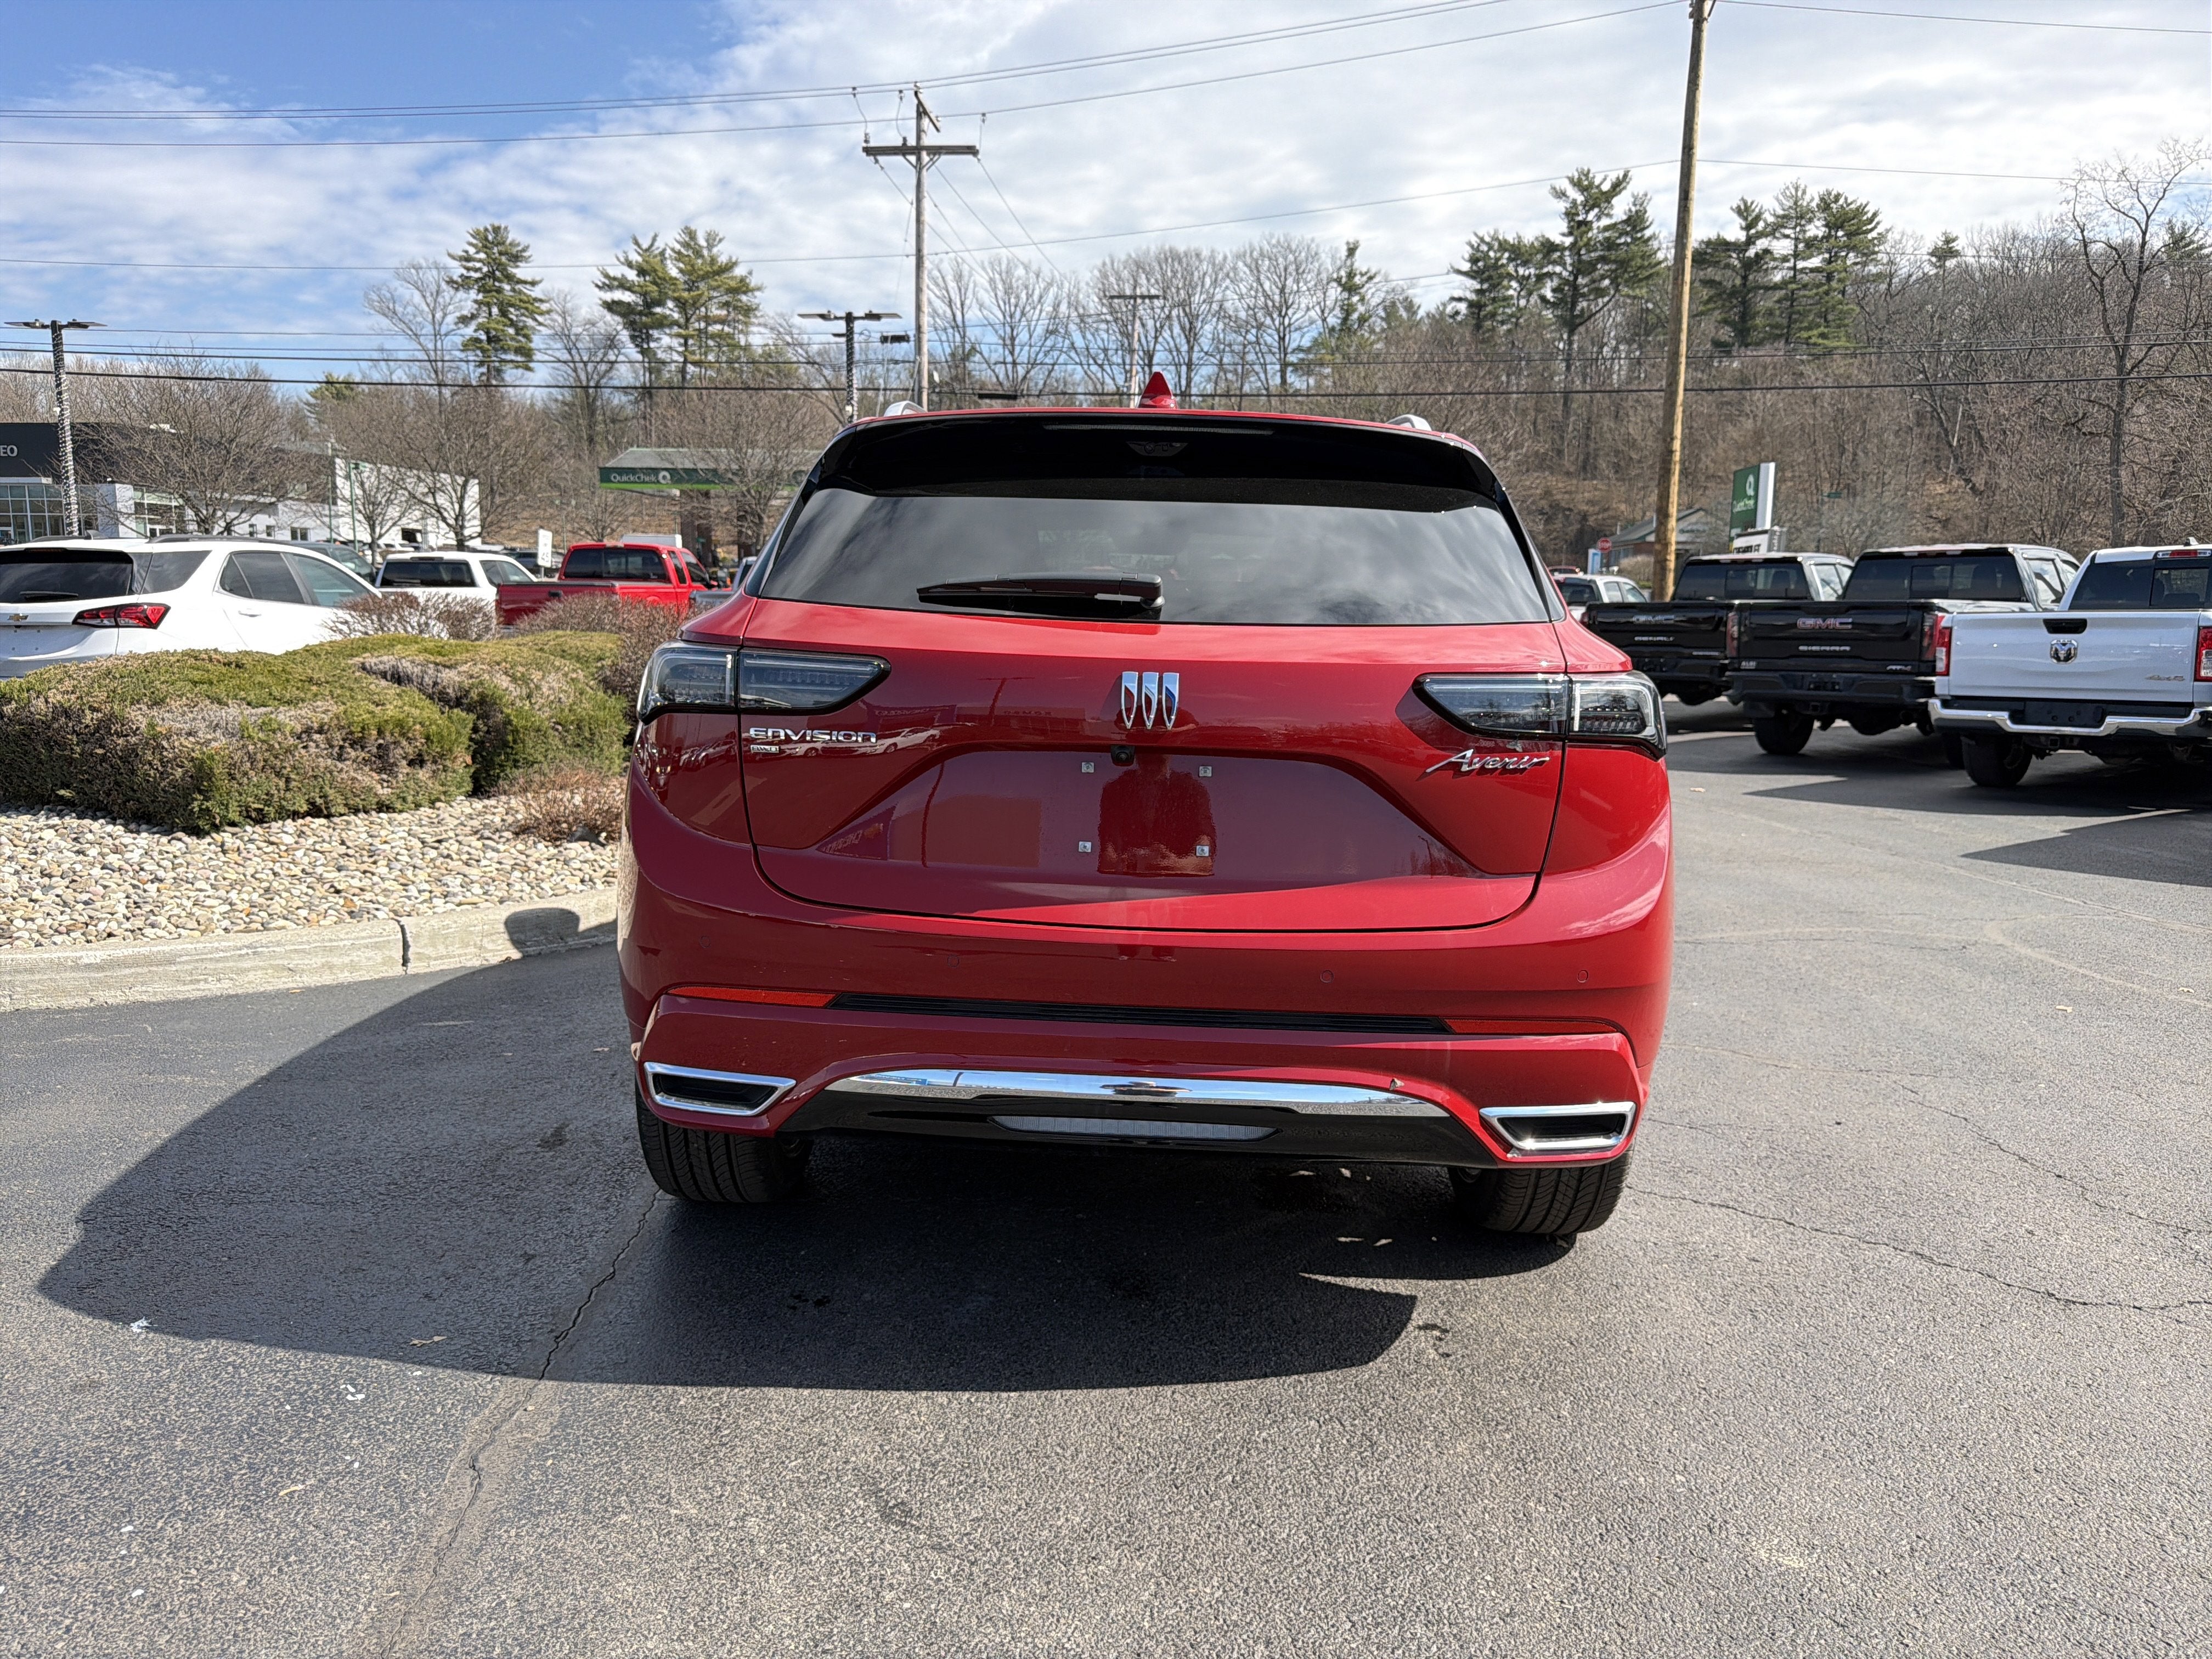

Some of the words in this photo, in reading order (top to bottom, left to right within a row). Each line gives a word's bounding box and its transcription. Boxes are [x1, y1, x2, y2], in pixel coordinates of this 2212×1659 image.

[1633, 615, 1675, 624] GMC
[1797, 618, 1853, 629] GMC
[749, 727, 877, 743] ENVISION
[1426, 749, 1550, 772] Avenir
